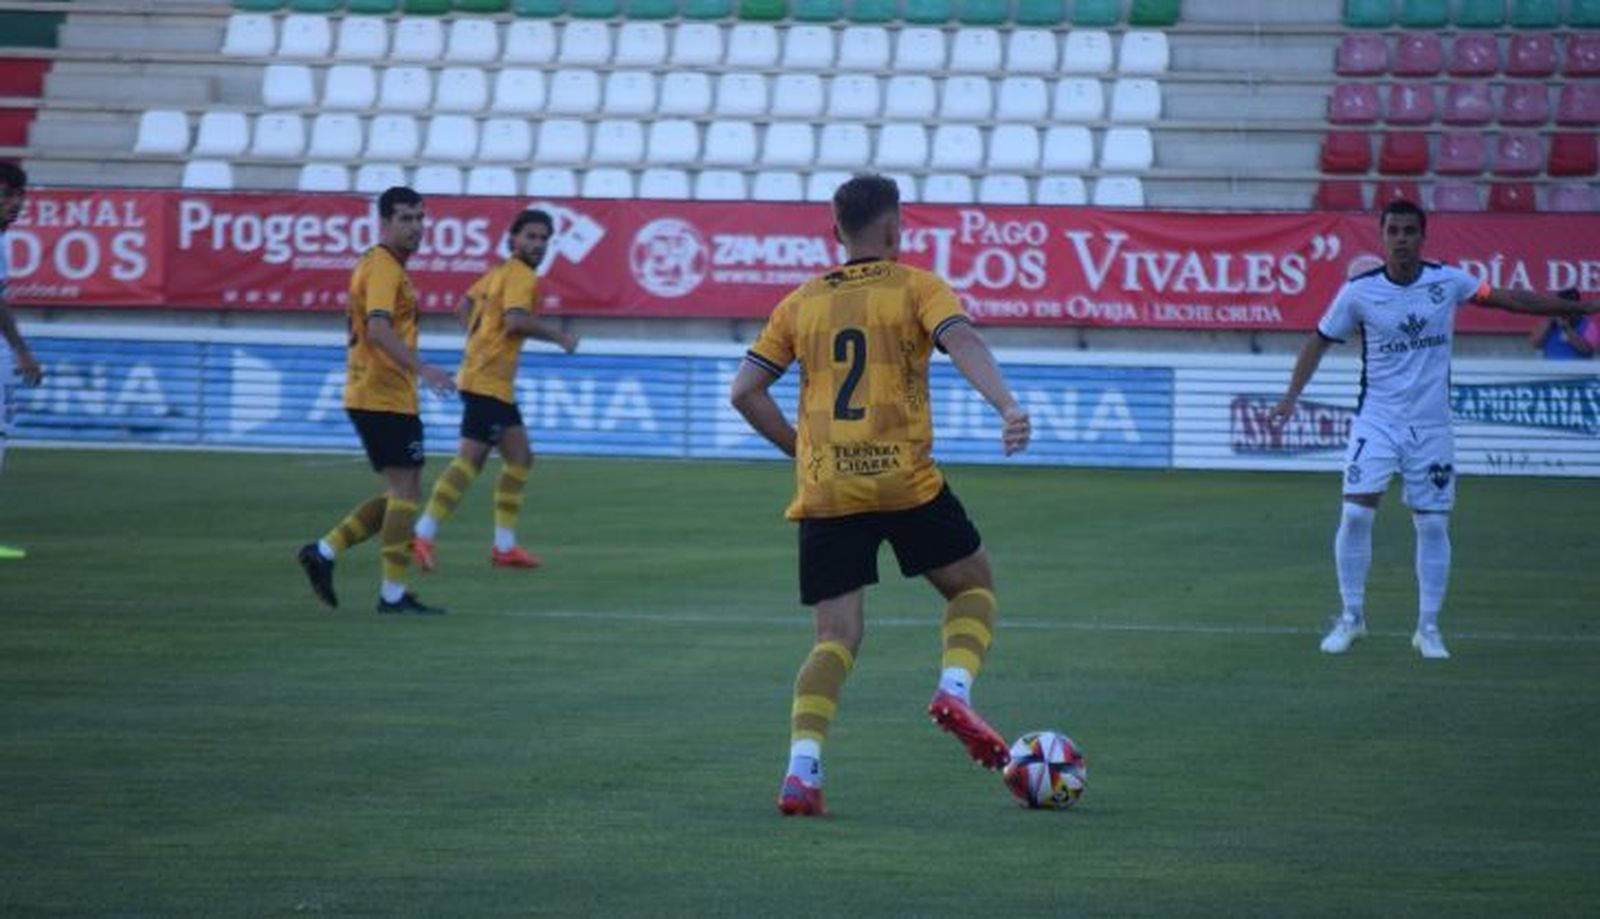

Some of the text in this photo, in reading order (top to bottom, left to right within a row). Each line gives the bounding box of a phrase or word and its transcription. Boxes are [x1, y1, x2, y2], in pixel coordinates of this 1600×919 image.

[178, 200, 491, 264] Progesdtos
[959, 209, 1048, 245] PAGO
[711, 234, 832, 268] ZAMORA
[833, 326, 868, 421] 2
[1353, 437, 1367, 462] 7
